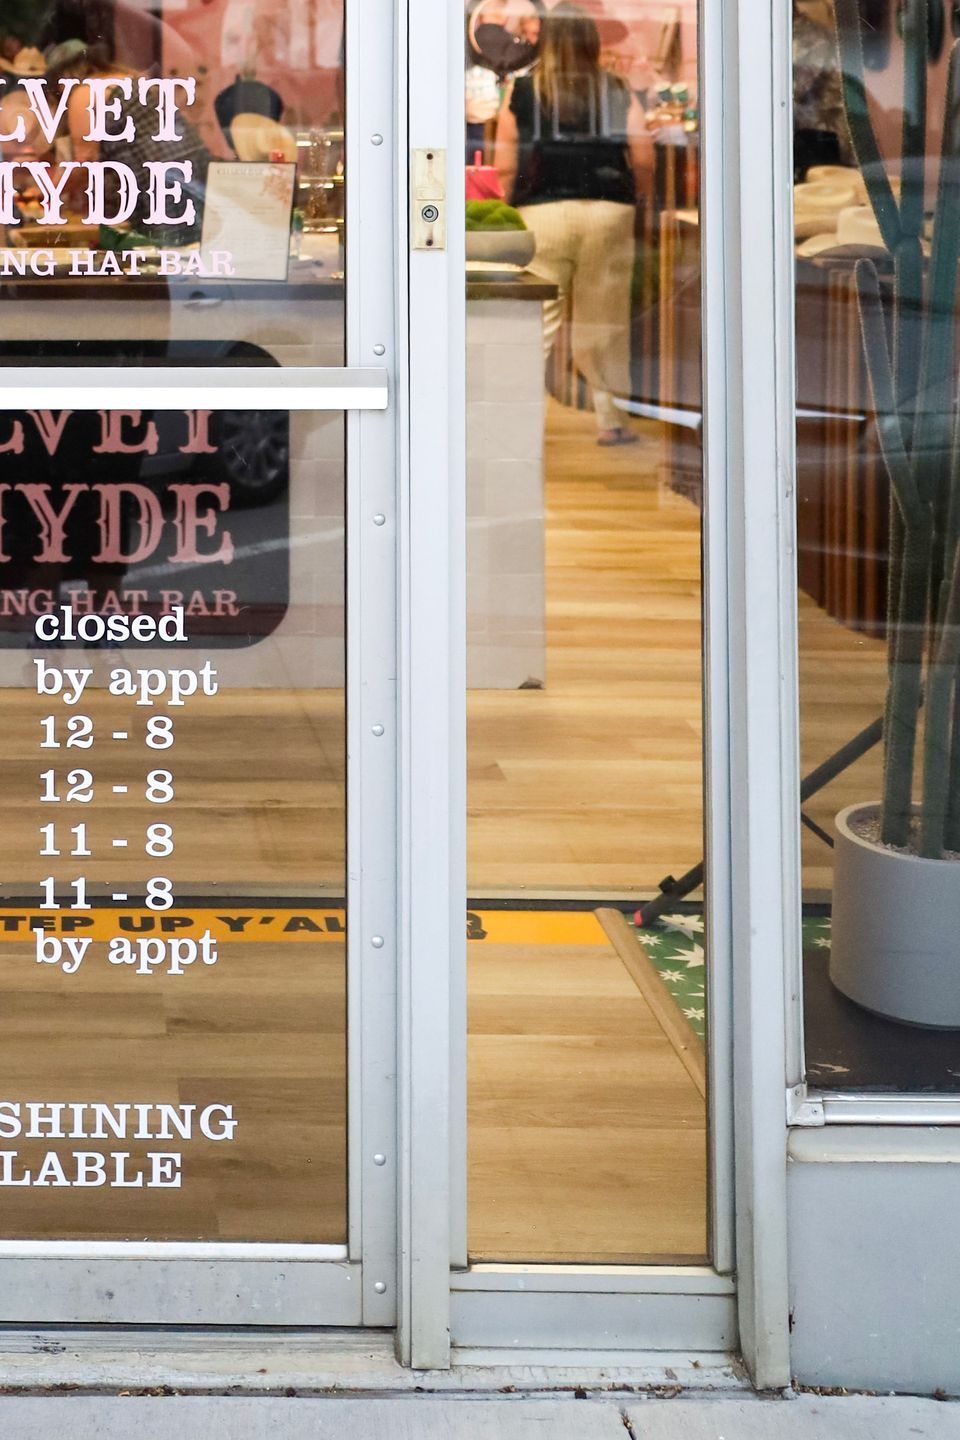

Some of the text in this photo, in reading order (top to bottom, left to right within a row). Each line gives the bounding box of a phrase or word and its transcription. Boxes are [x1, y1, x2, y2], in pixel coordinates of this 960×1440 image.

[68, 249, 146, 276] HAT
[160, 249, 237, 276] BAR
[67, 589, 149, 616] HAT
[159, 589, 241, 617] BAR
[35, 606, 188, 642] closed
[34, 659, 94, 704] by
[109, 661, 218, 705] appt
[39, 715, 94, 749] 12
[112, 731, 128, 740] -
[145, 716, 174, 749] 8
[39, 769, 94, 803] 12
[112, 784, 128, 794] -
[145, 769, 174, 803] 8
[39, 823, 91, 856] 11
[112, 838, 128, 848] -
[145, 823, 174, 857] 8
[39, 876, 91, 909] 11
[112, 892, 128, 902] -
[145, 877, 174, 911] 8
[118, 916, 194, 933] UP
[215, 916, 345, 933] Y'AL
[33, 927, 93, 973] by
[108, 929, 218, 974] appt
